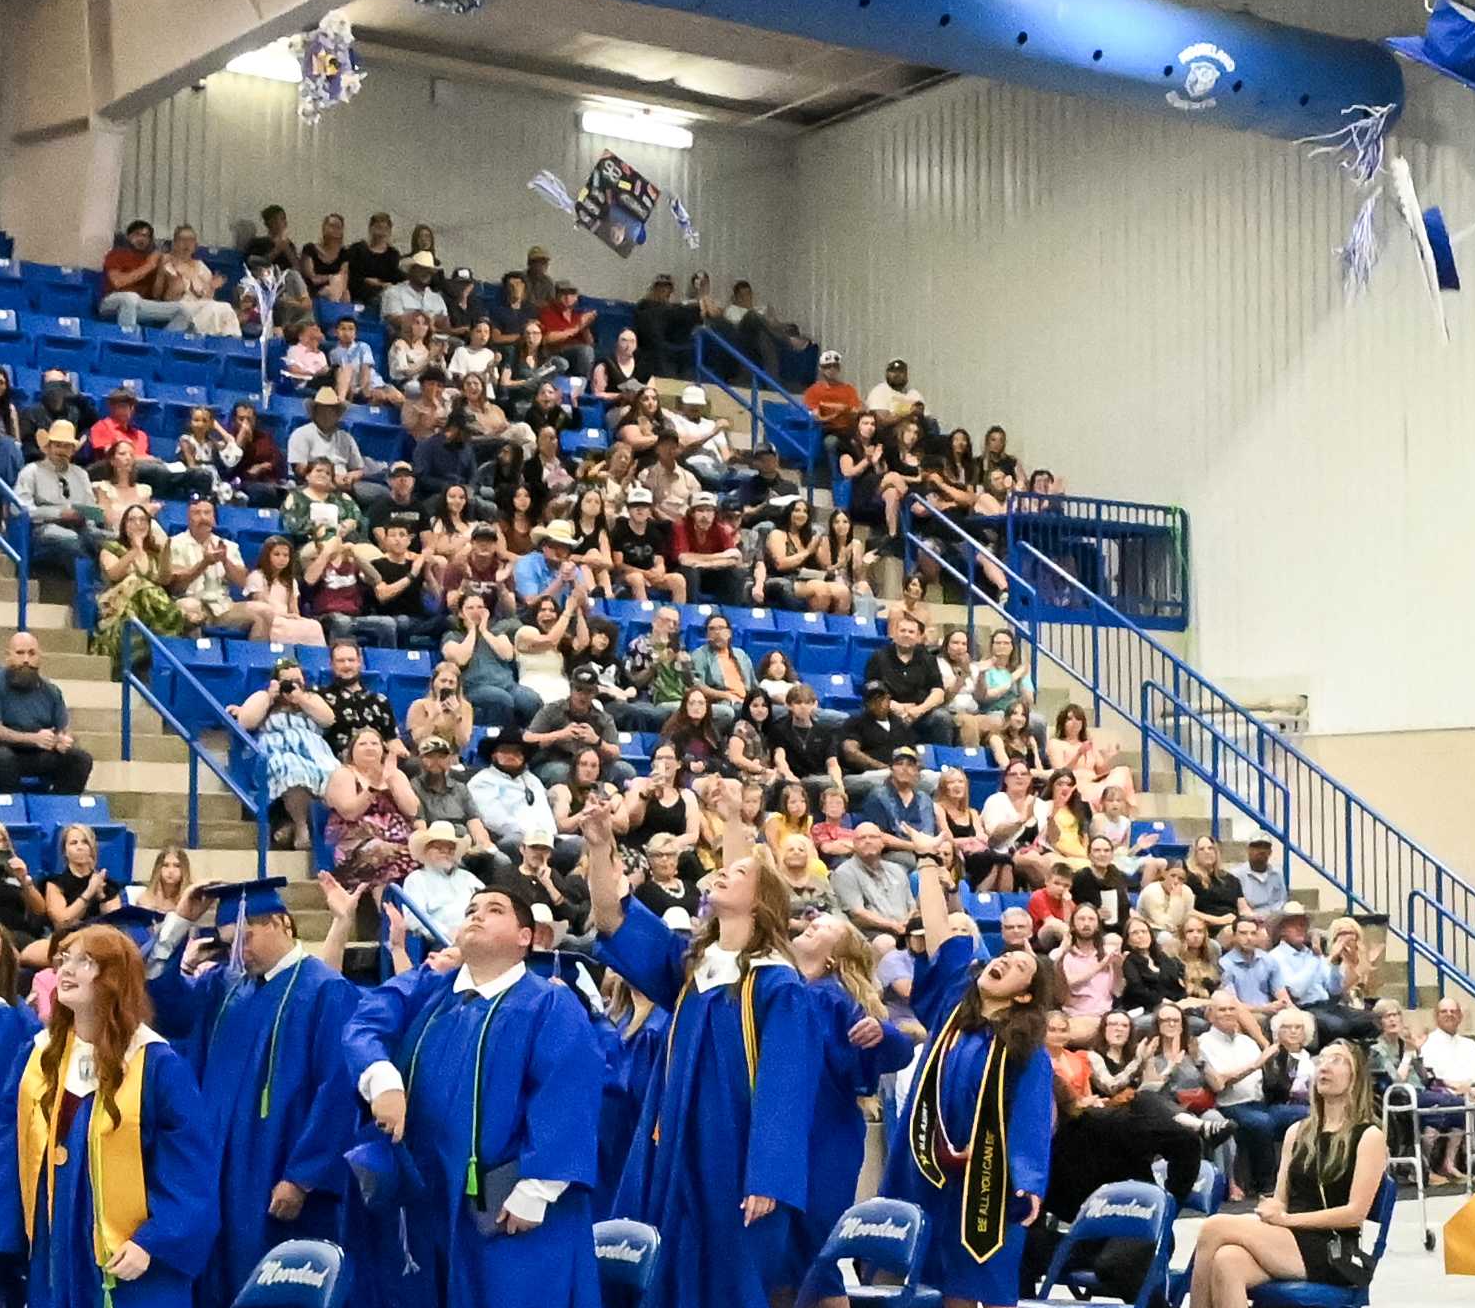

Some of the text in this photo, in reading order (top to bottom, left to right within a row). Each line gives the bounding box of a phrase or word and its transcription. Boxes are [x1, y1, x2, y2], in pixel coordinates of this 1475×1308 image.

[982, 1145, 993, 1171] CAN
[981, 1171, 990, 1196] YOU
[979, 1195, 989, 1217] ALL
[838, 1217, 908, 1240] Mooreland
